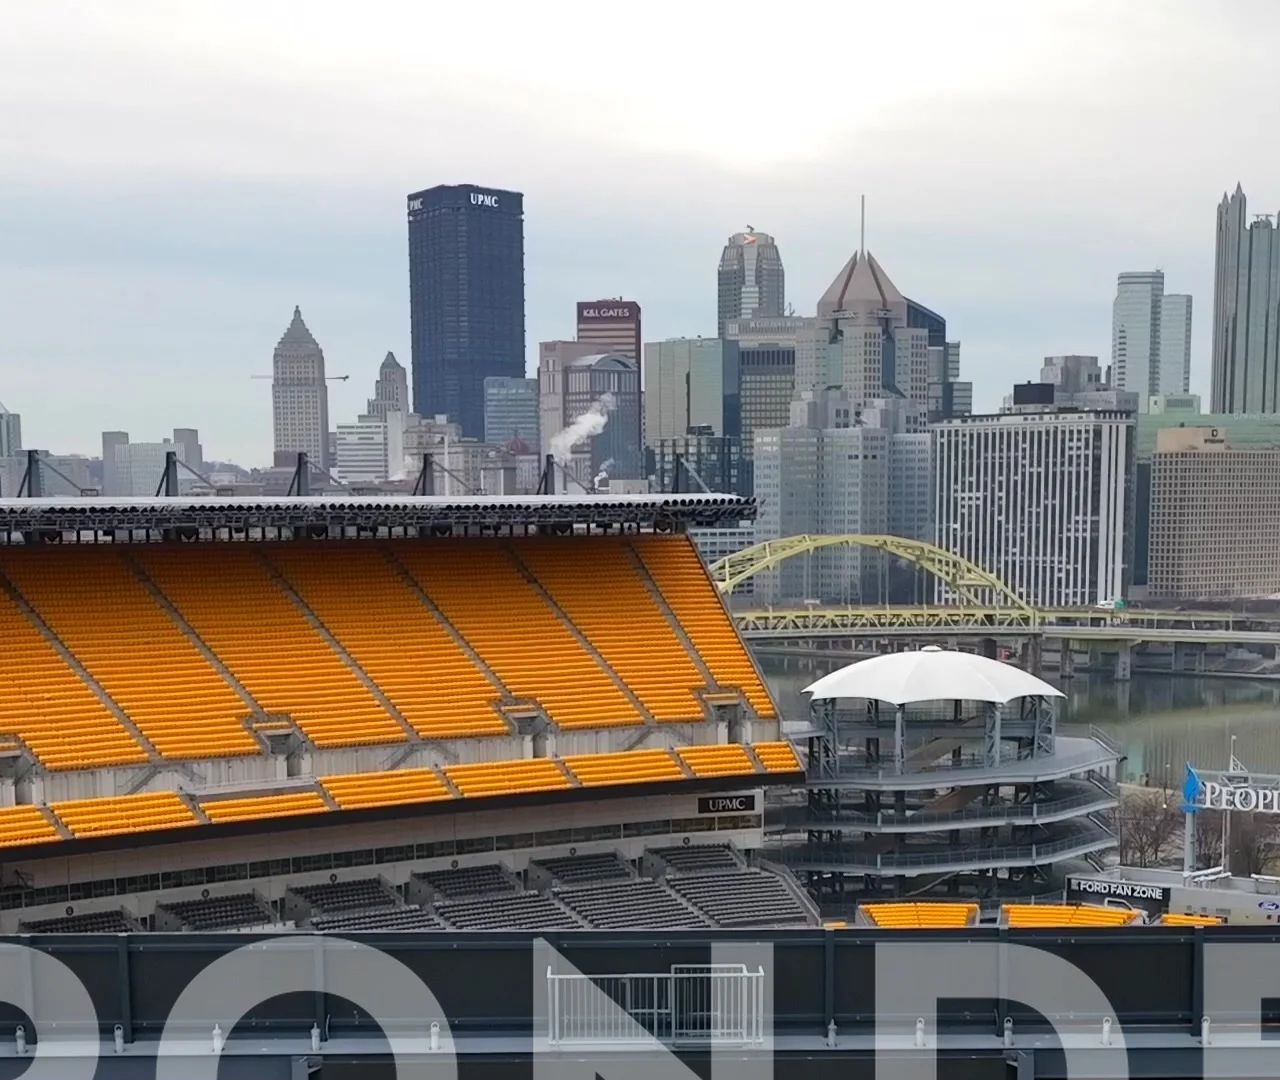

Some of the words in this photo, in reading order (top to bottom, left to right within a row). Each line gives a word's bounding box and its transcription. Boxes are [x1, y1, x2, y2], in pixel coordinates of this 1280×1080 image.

[470, 193, 499, 207] UPMC
[600, 308, 630, 317] GATES
[709, 798, 746, 811] UPMC
[1080, 881, 1109, 894] FORD
[1110, 884, 1132, 896] FAN
[1133, 886, 1163, 900] ZONE
